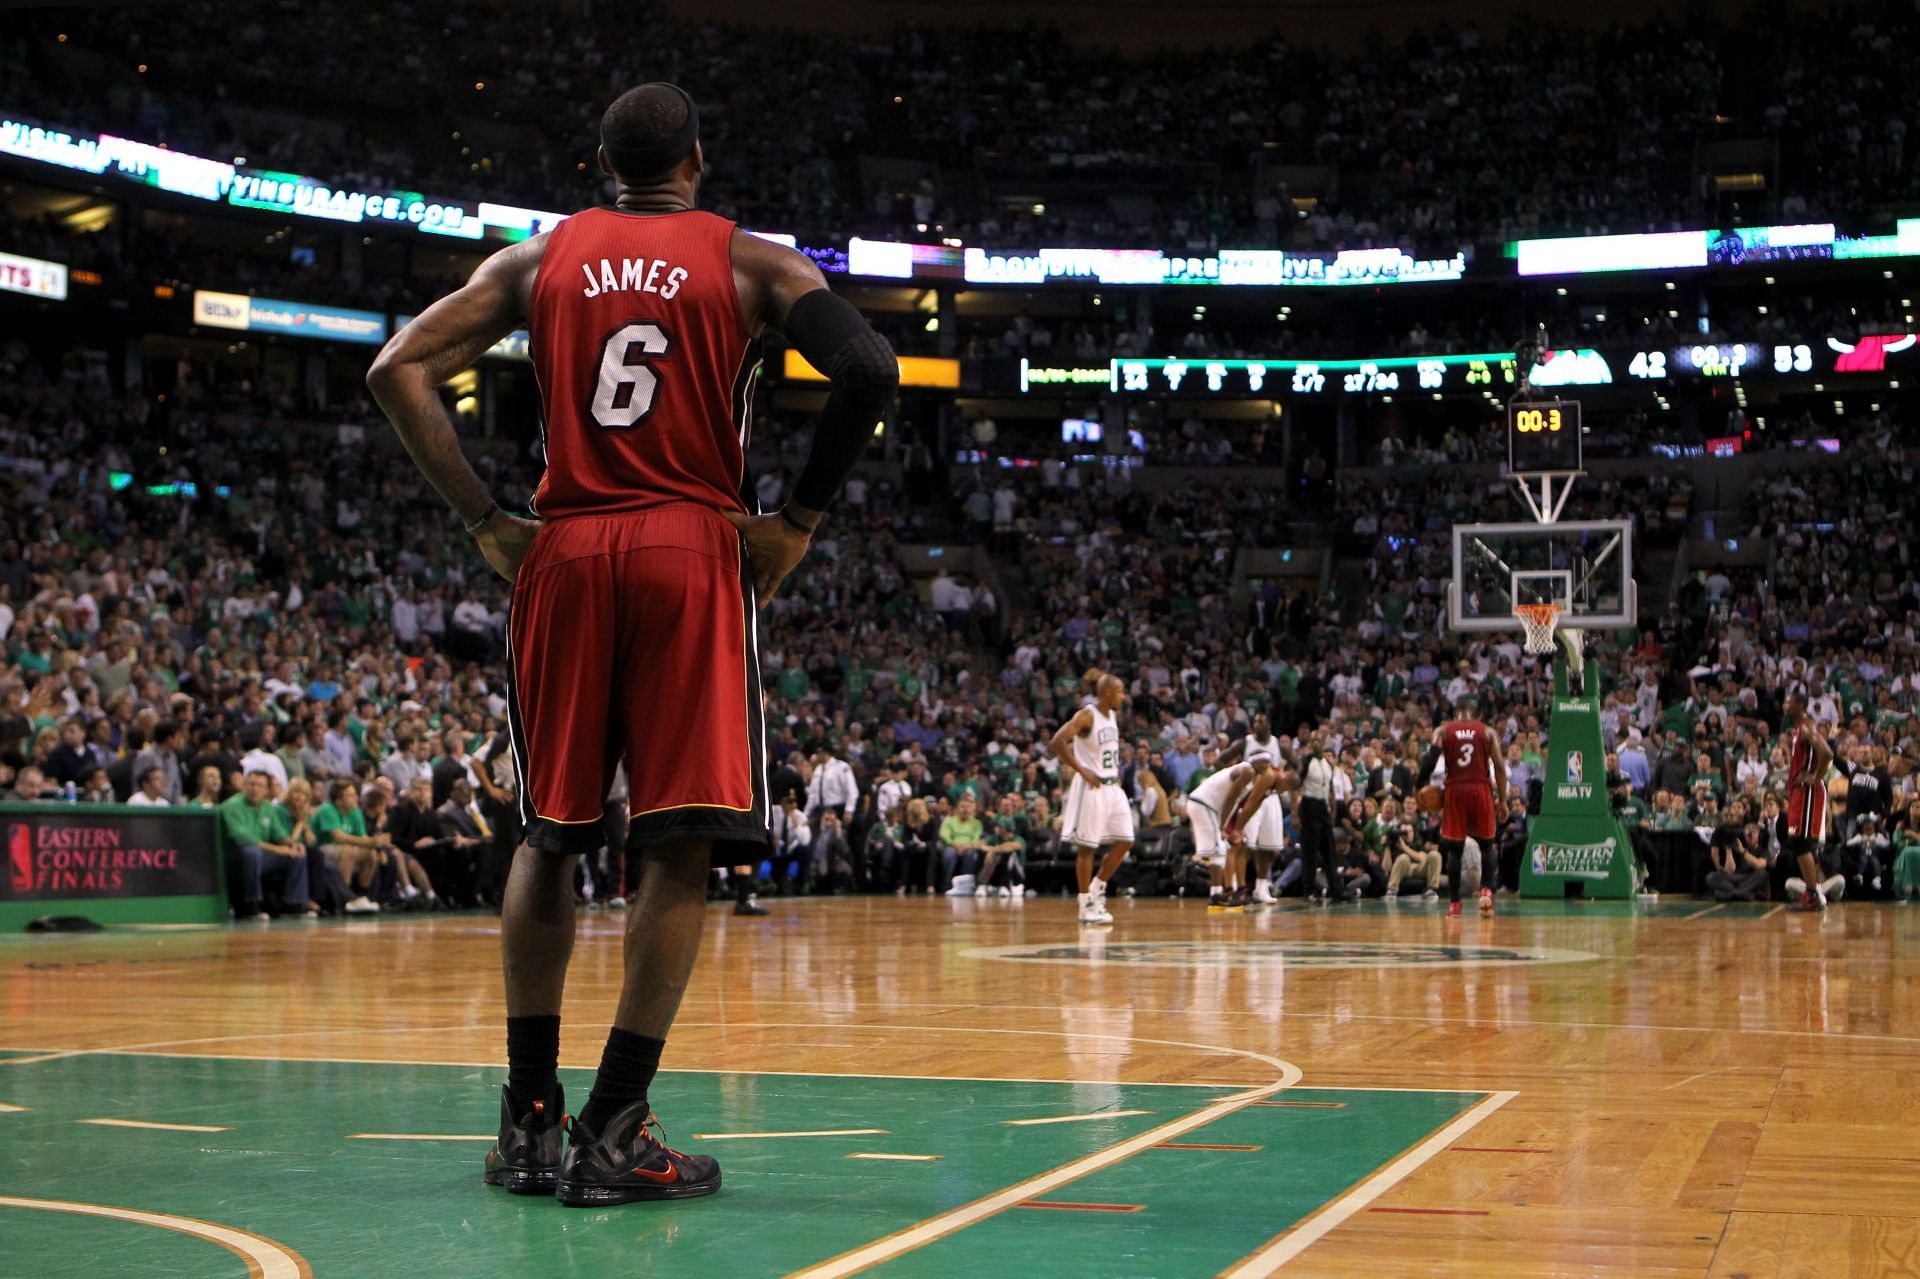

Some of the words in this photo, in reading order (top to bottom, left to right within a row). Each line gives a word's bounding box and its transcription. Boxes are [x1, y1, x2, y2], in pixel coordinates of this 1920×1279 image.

[582, 258, 689, 300] JAMES
[1628, 351, 1666, 378] 42
[1774, 345, 1812, 372] 53
[590, 322, 670, 428] 6
[1517, 409, 1561, 432] 00.3
[1457, 743, 1474, 767] 3
[1558, 786, 1578, 798] NBA
[1579, 786, 1593, 798] TV
[37, 825, 121, 849] EASTERN
[37, 849, 178, 869] CONFERENCE
[1547, 846, 1614, 860] EASTERN
[36, 870, 123, 890] FINALS
